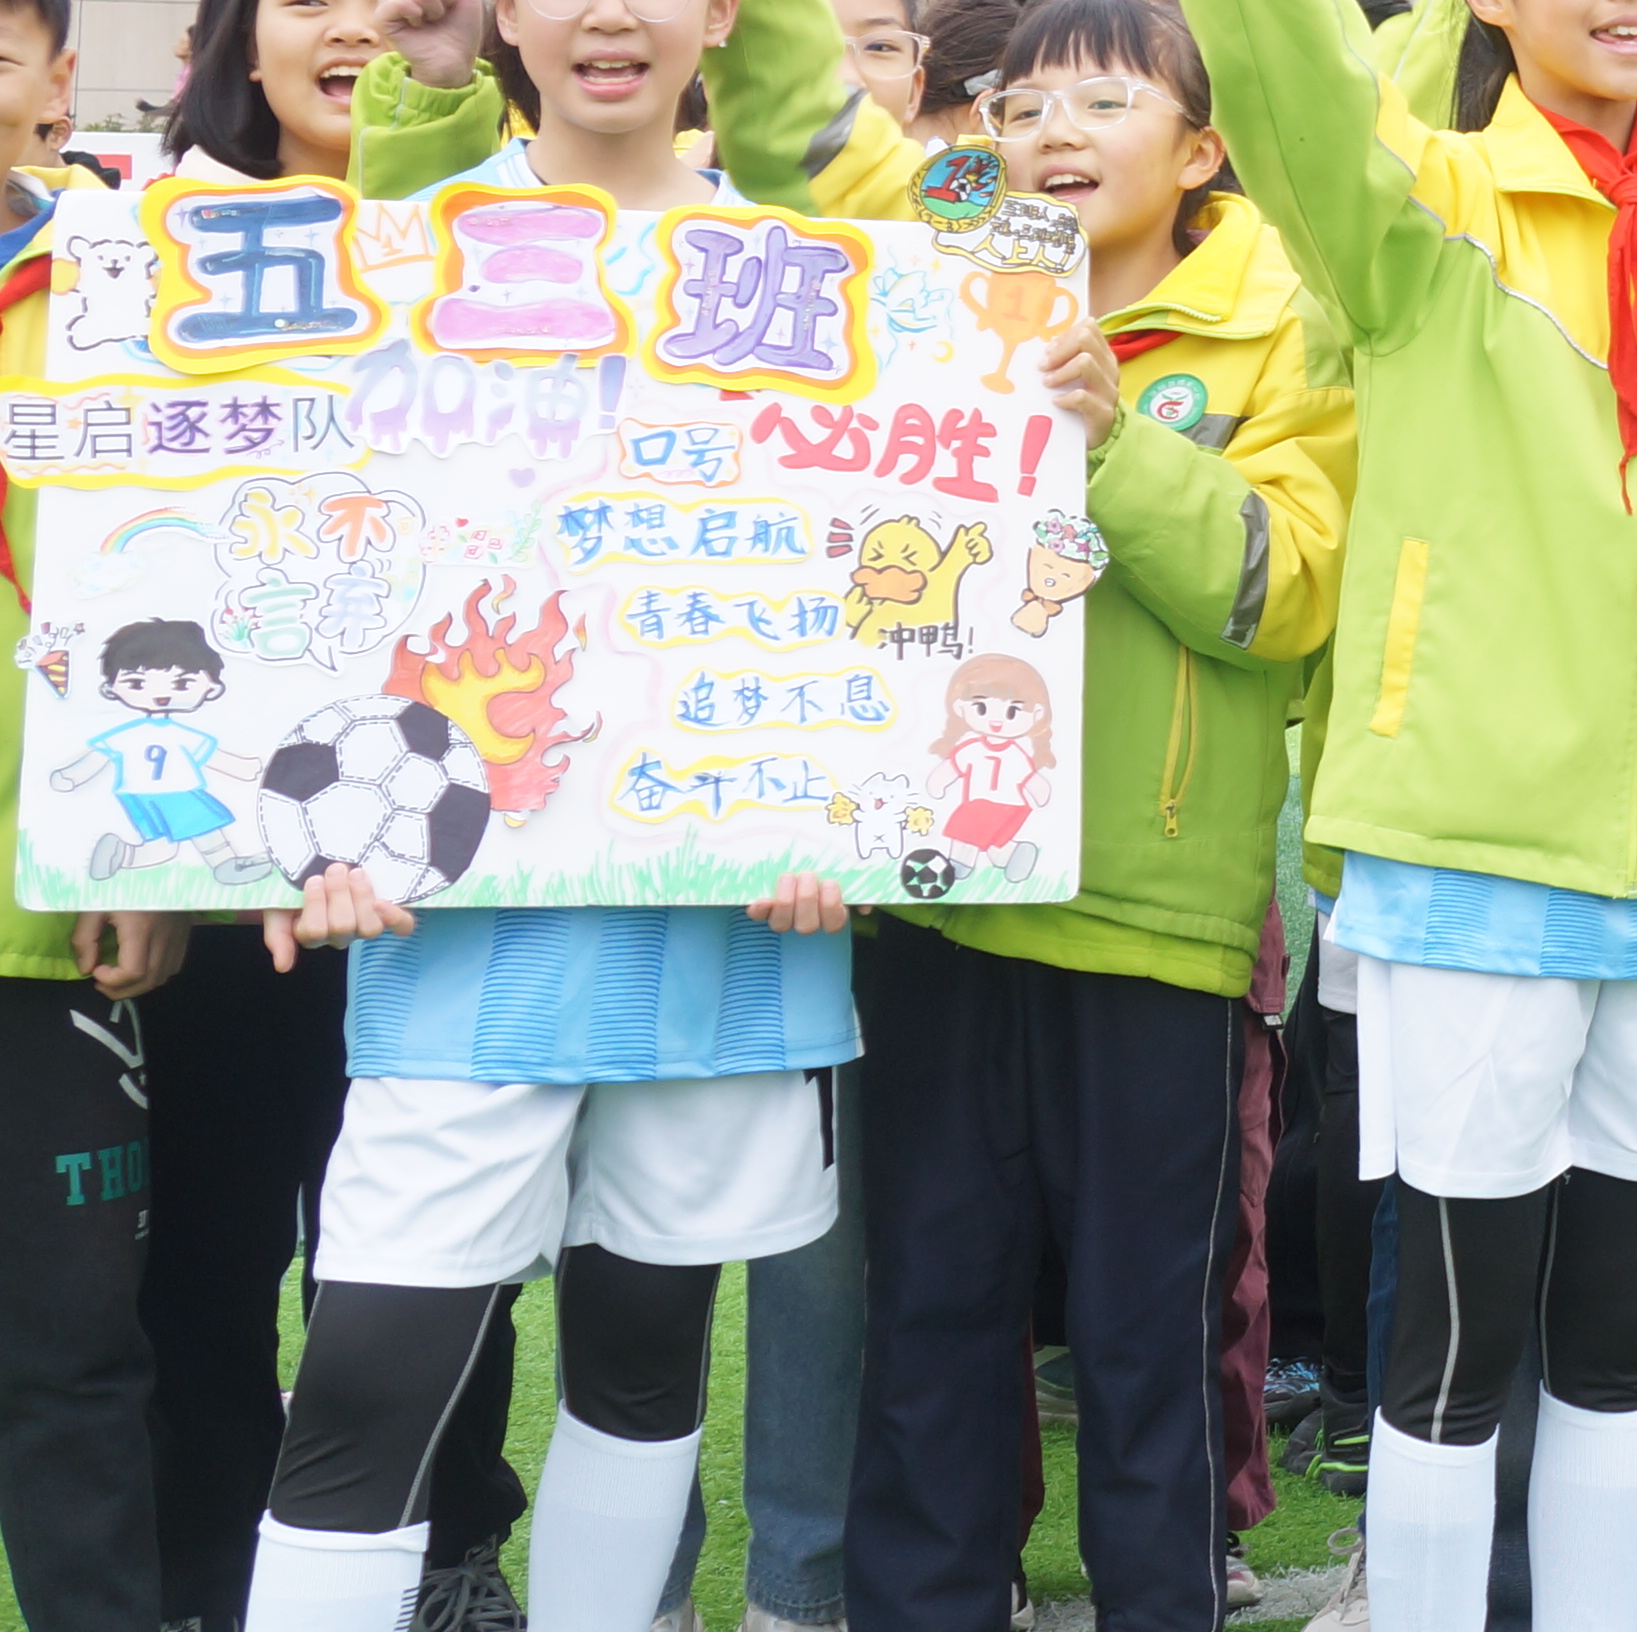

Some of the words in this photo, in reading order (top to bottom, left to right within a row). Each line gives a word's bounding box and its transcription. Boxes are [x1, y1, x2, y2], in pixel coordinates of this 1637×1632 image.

[175, 196, 849, 372] 五三班
[3, 393, 356, 463] 星启逐梦队
[629, 427, 736, 483] 口号
[556, 499, 807, 567] 梦想启航
[626, 589, 840, 642] 青春飞扬
[676, 670, 891, 728] 追梦不息
[144, 744, 168, 781] 9
[617, 752, 831, 817] 奋斗不止
